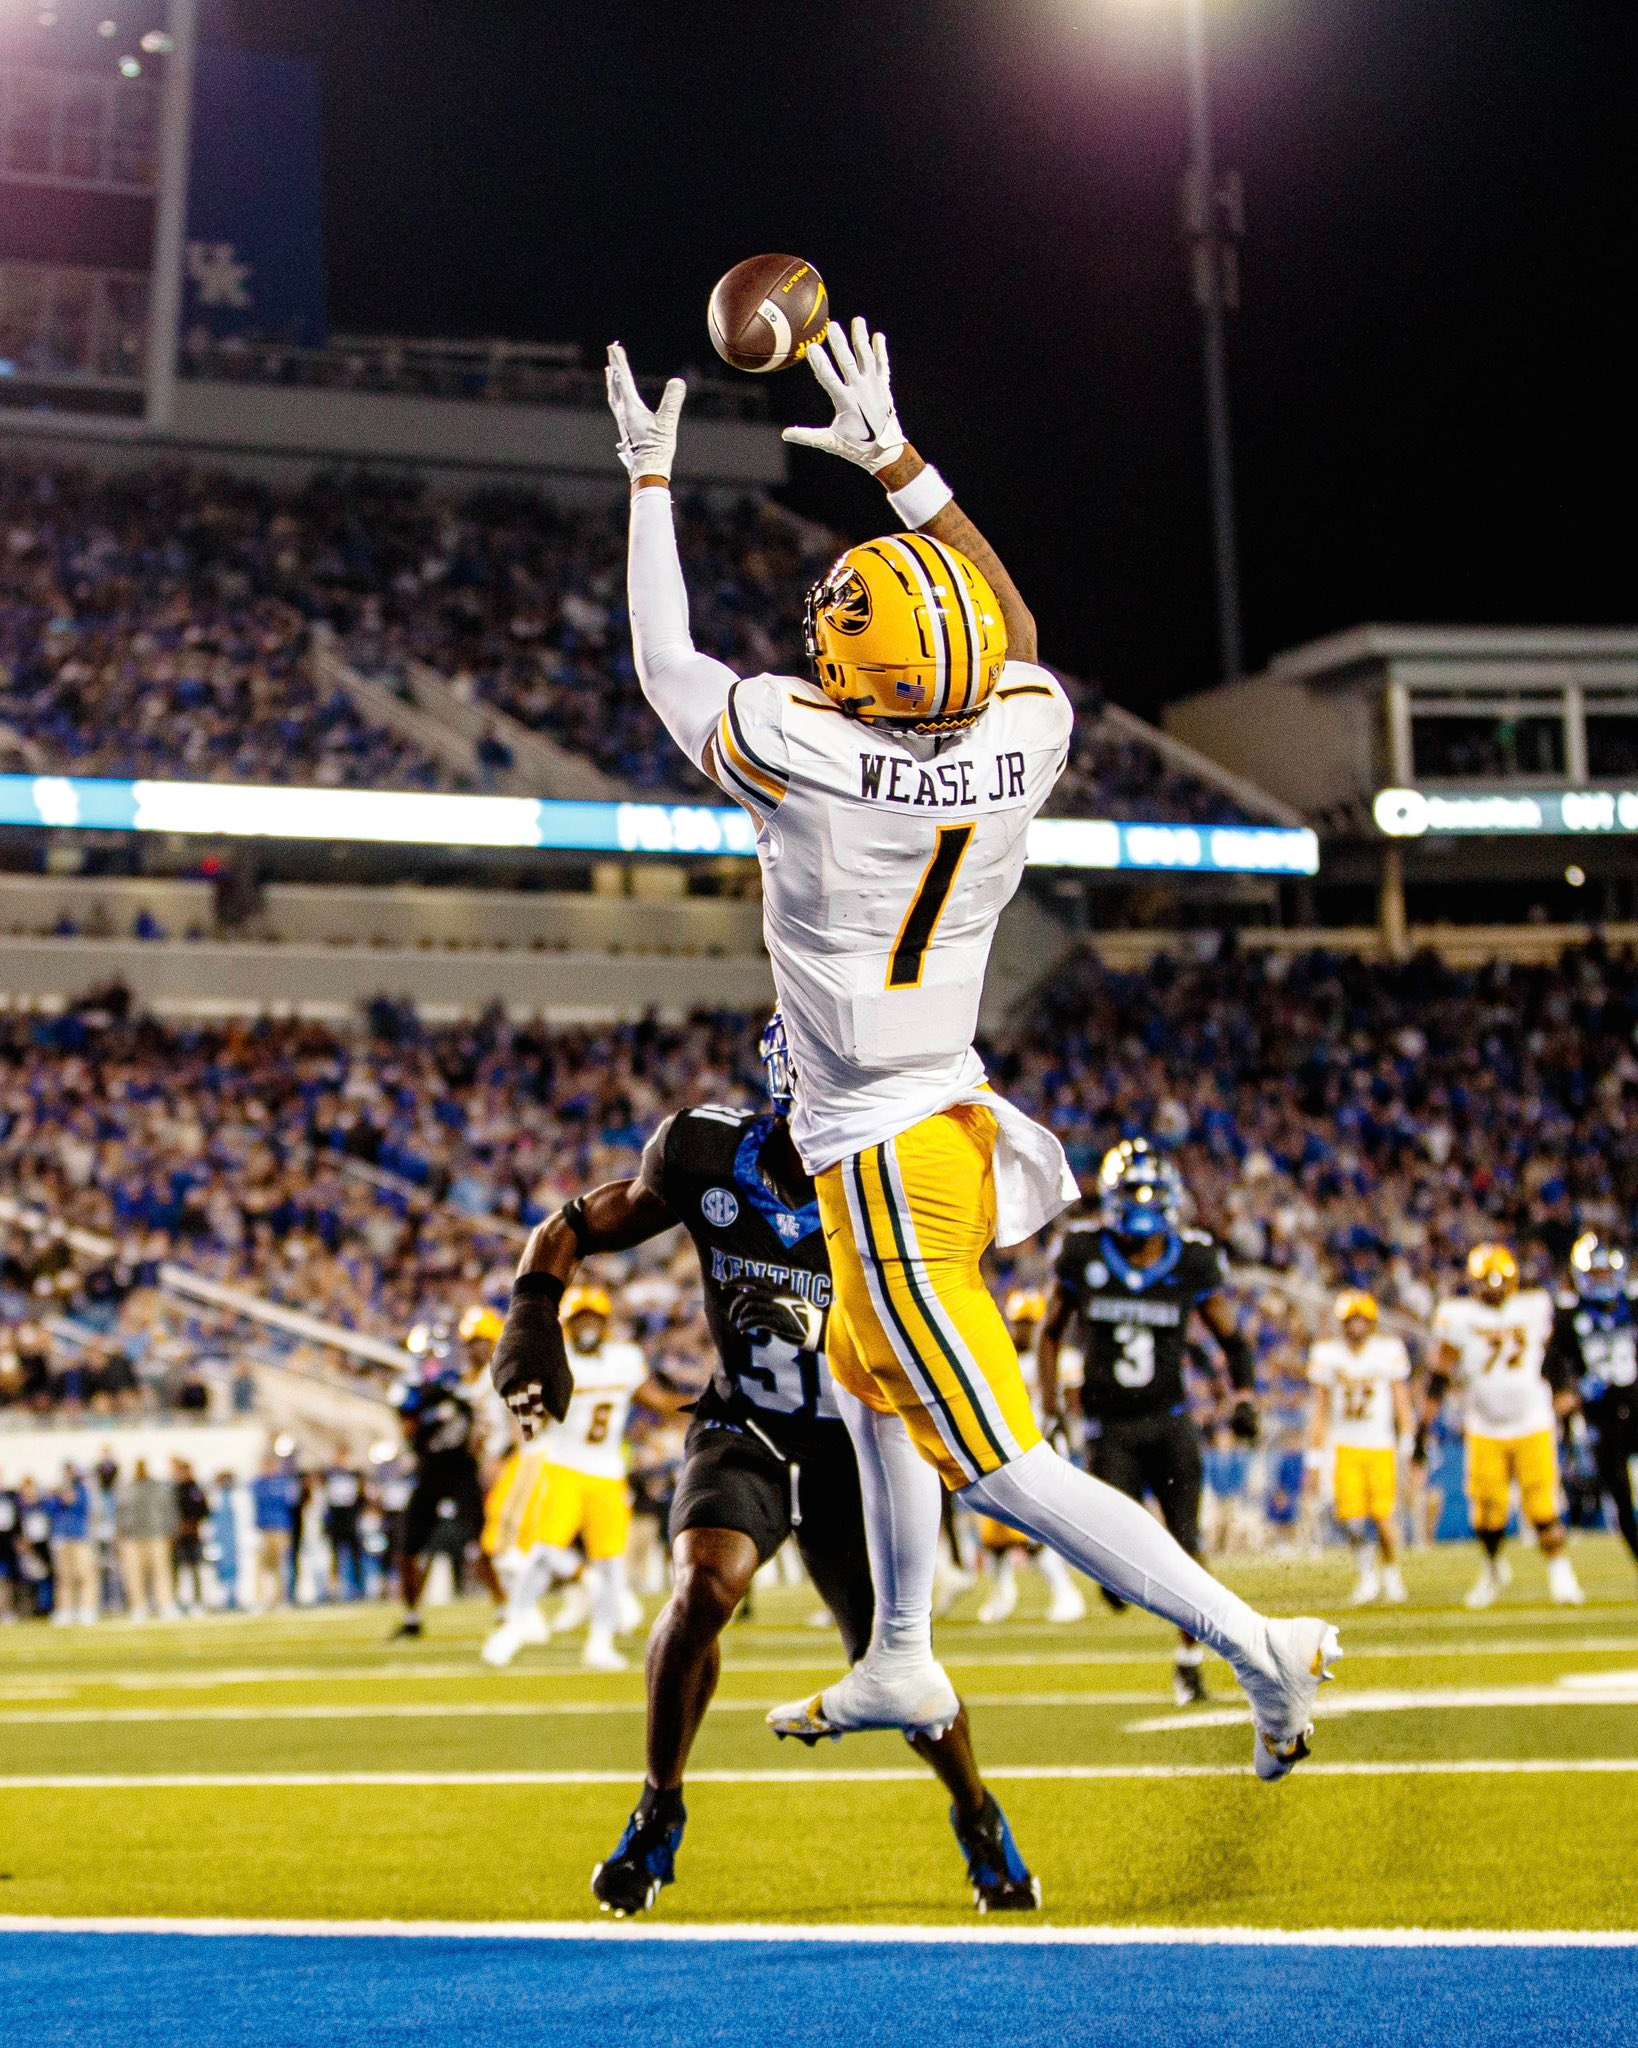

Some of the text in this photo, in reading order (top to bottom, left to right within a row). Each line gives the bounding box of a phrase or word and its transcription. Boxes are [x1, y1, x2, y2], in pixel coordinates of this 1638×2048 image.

[859, 751, 1025, 806] WEASE JR
[703, 1190, 737, 1225] SEC
[1113, 1323, 1155, 1388] 3
[1473, 1326, 1530, 1375] 72
